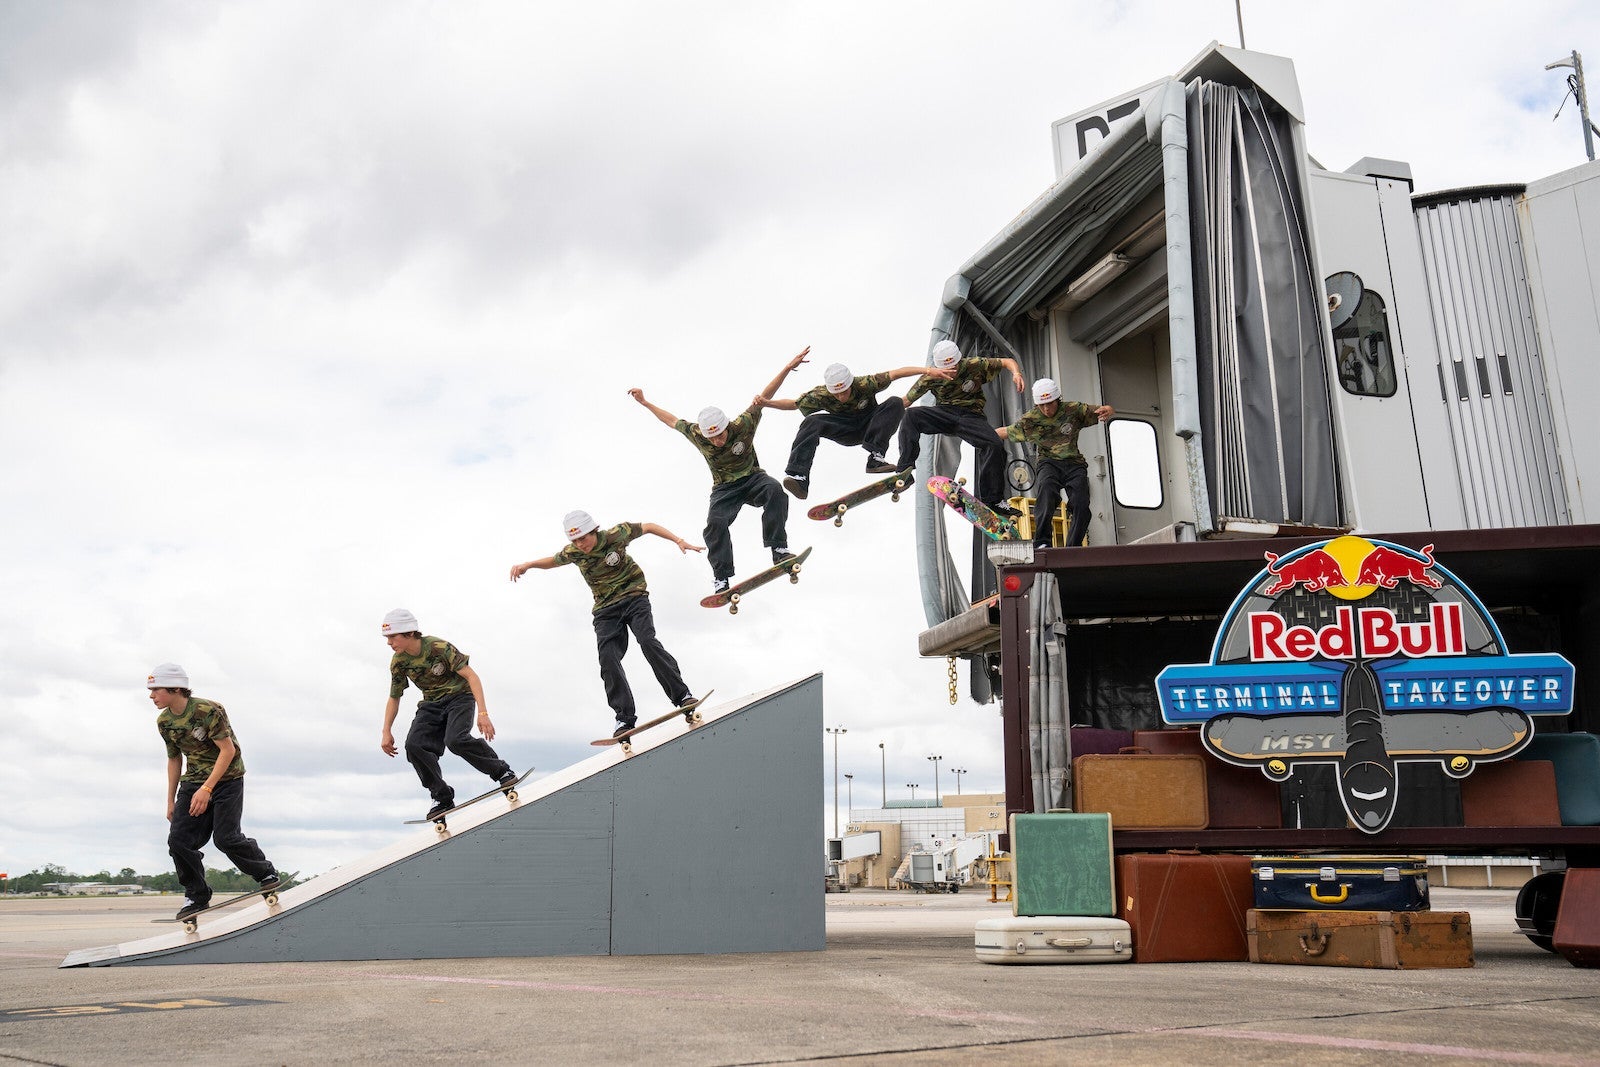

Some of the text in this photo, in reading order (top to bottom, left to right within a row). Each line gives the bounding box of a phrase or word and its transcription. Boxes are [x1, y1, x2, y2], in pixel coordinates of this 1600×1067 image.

[1250, 605, 1464, 659] Red Bull
[1173, 679, 1559, 709] TERMINAL TAKEOVER
[1261, 733, 1335, 751] MSY
